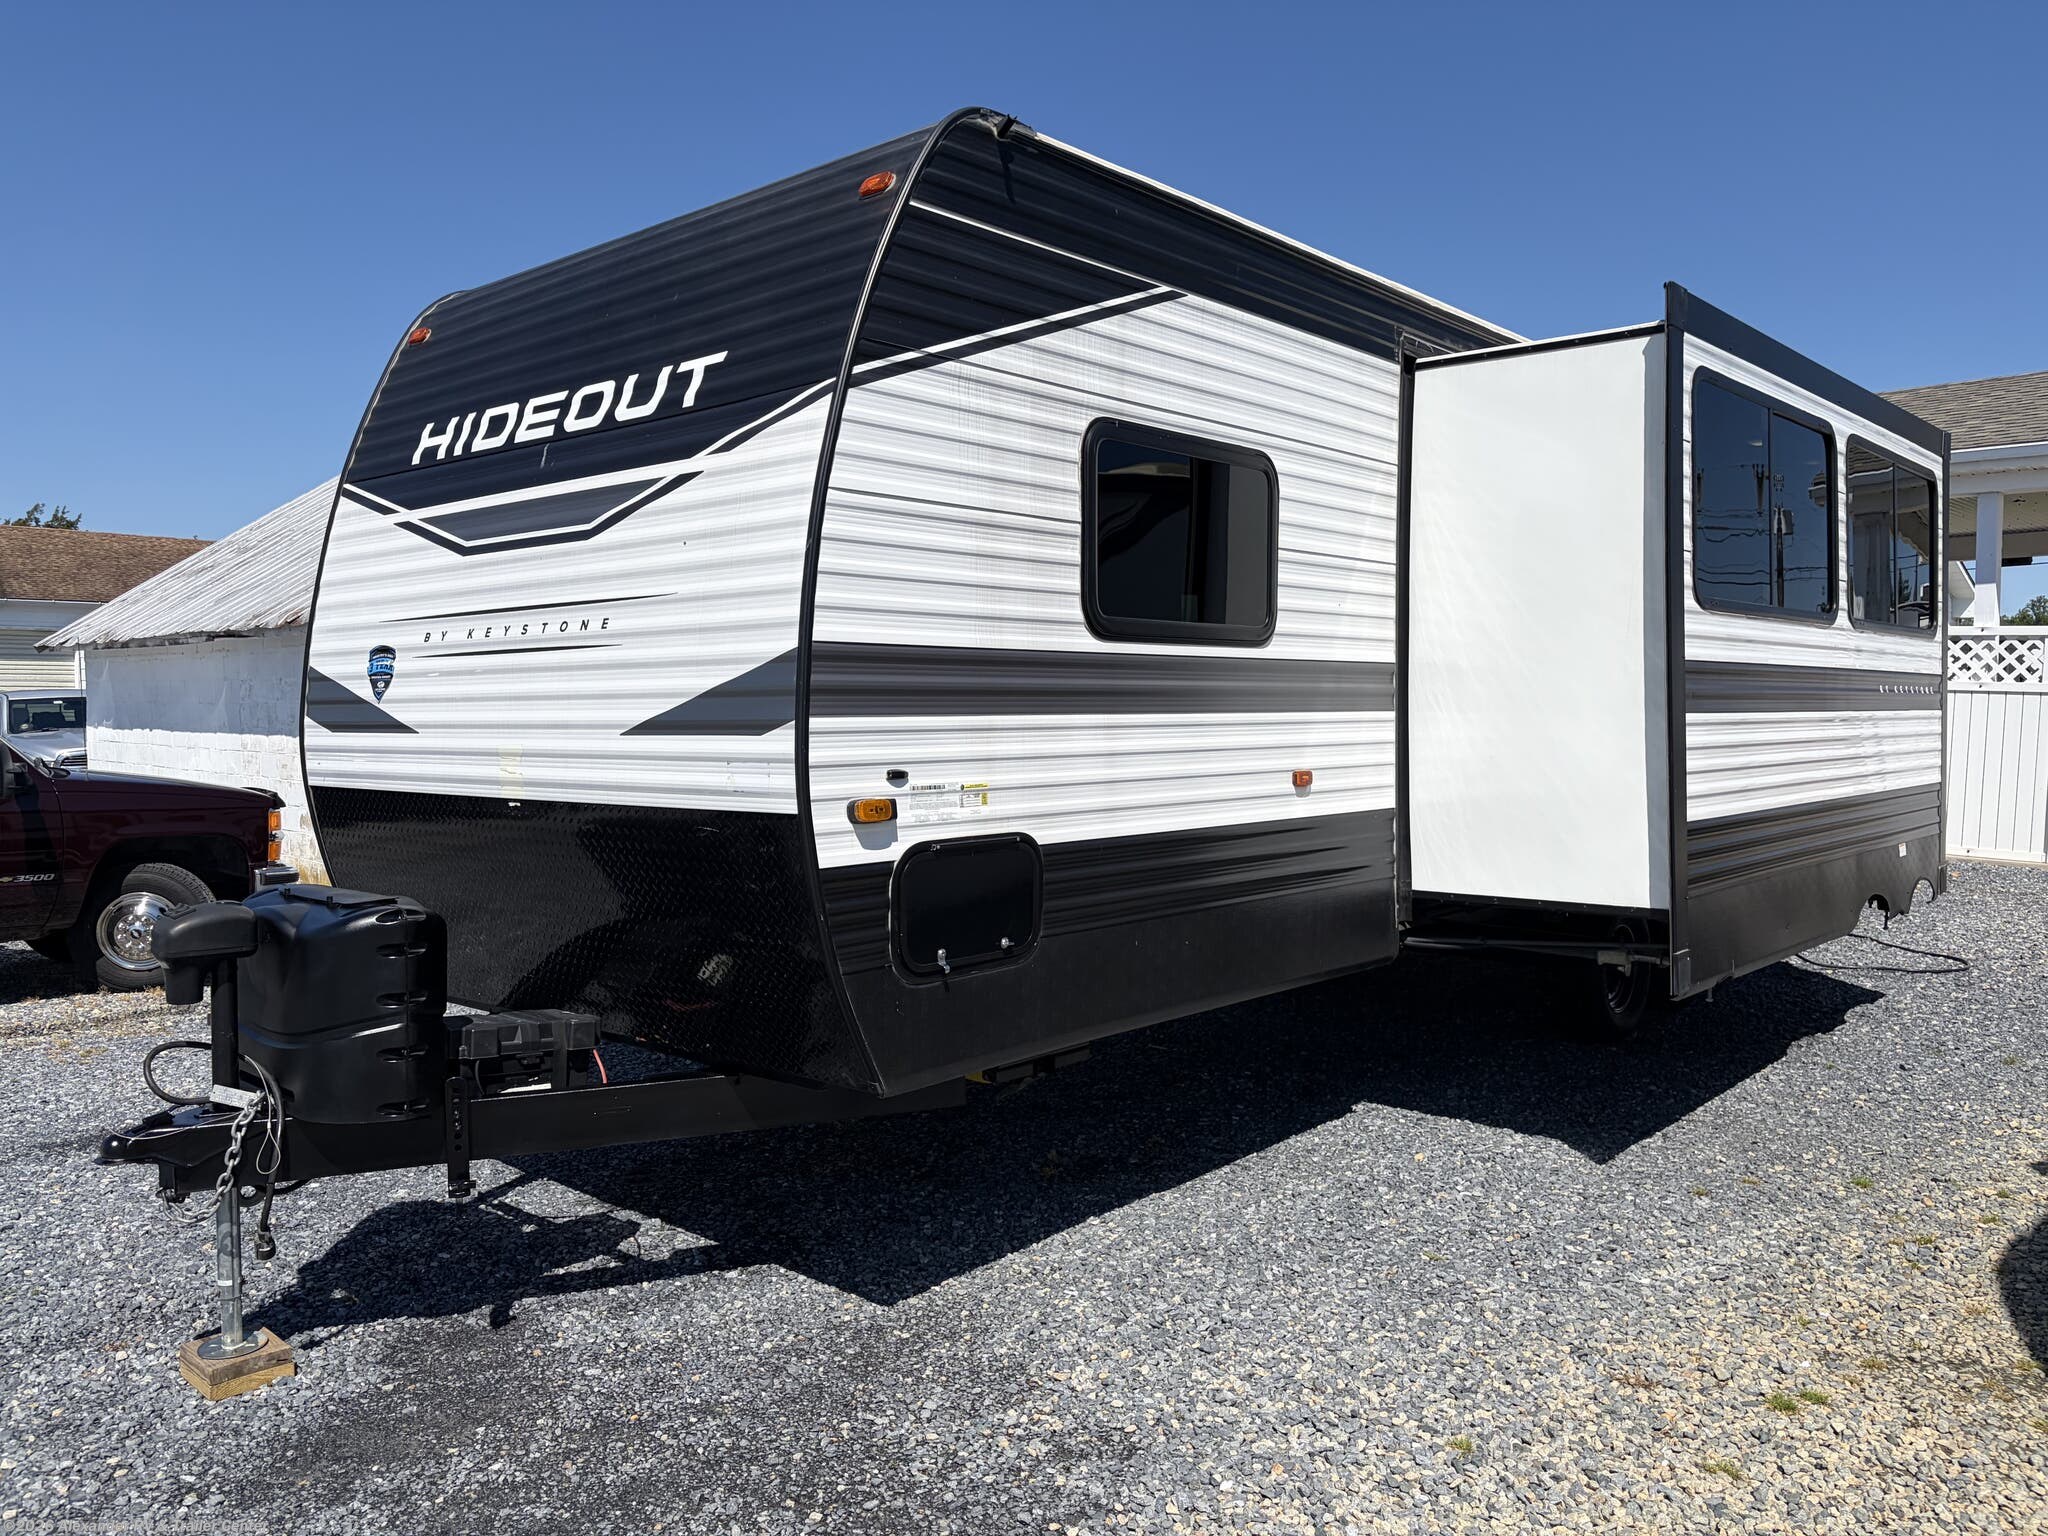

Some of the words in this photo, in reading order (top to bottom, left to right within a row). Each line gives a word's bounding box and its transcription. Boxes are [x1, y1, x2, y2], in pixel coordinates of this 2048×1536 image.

[411, 350, 729, 466] HIDEOUT
[423, 630, 448, 643] BY
[466, 617, 610, 640] KEYSTONE
[13, 873, 56, 883] 3500
